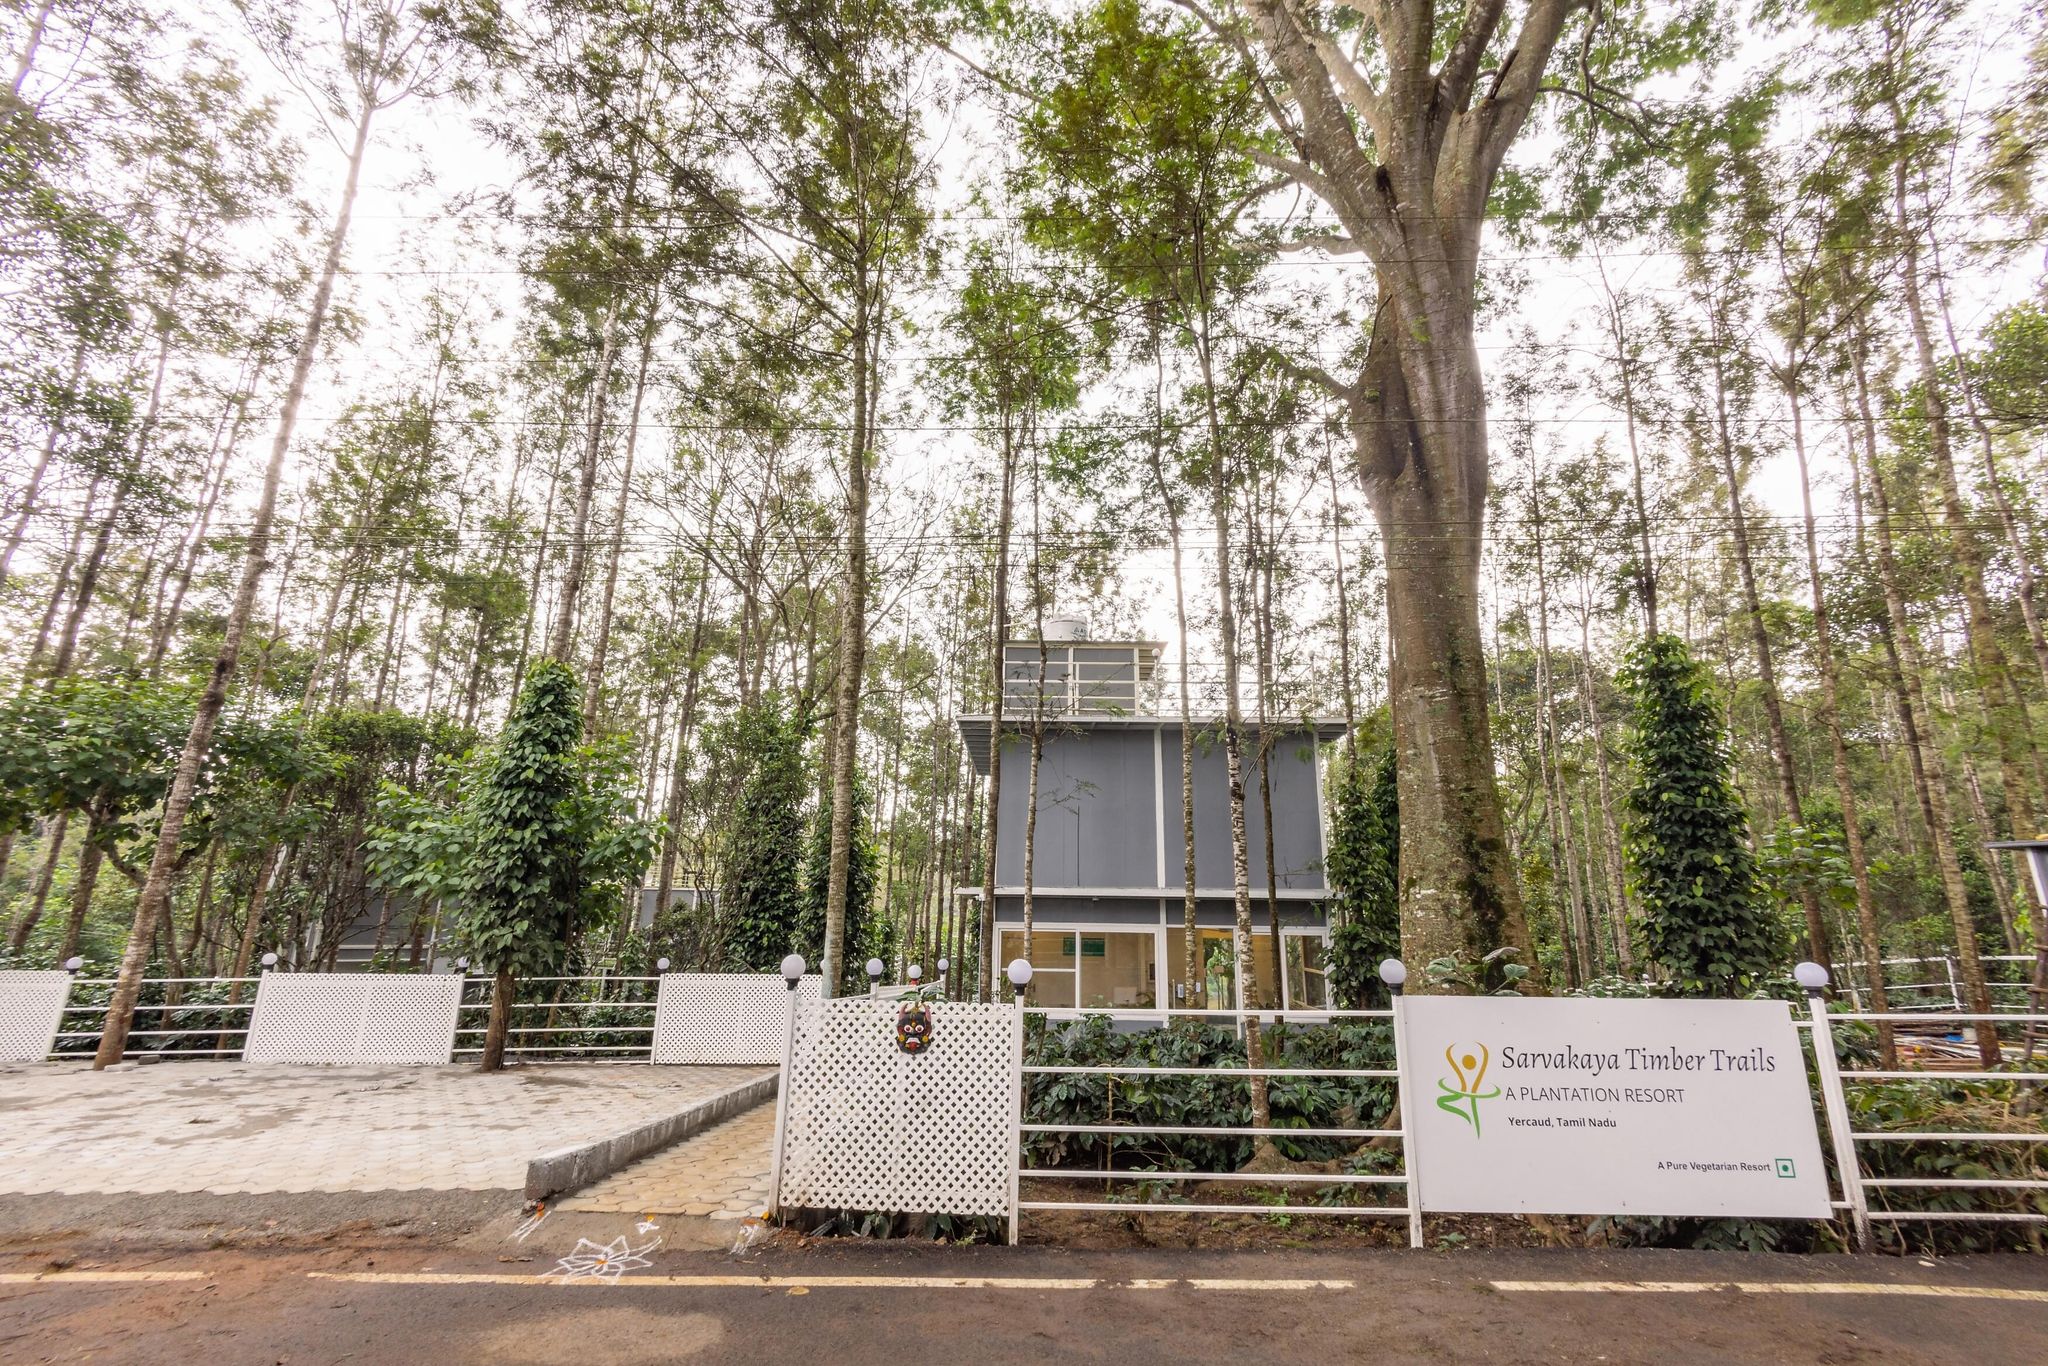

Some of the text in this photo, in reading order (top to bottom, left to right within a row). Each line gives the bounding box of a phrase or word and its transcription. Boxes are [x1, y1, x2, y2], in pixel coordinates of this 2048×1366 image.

[1502, 1045, 1776, 1077] Sarvakaya Timber Trails
[1505, 1086, 1685, 1103] A PLANTATION RESORT
[1508, 1116, 1617, 1129] Yercaud, Tamil Nadu
[1657, 1161, 1771, 1173] A Pure Vegetarian Resort
